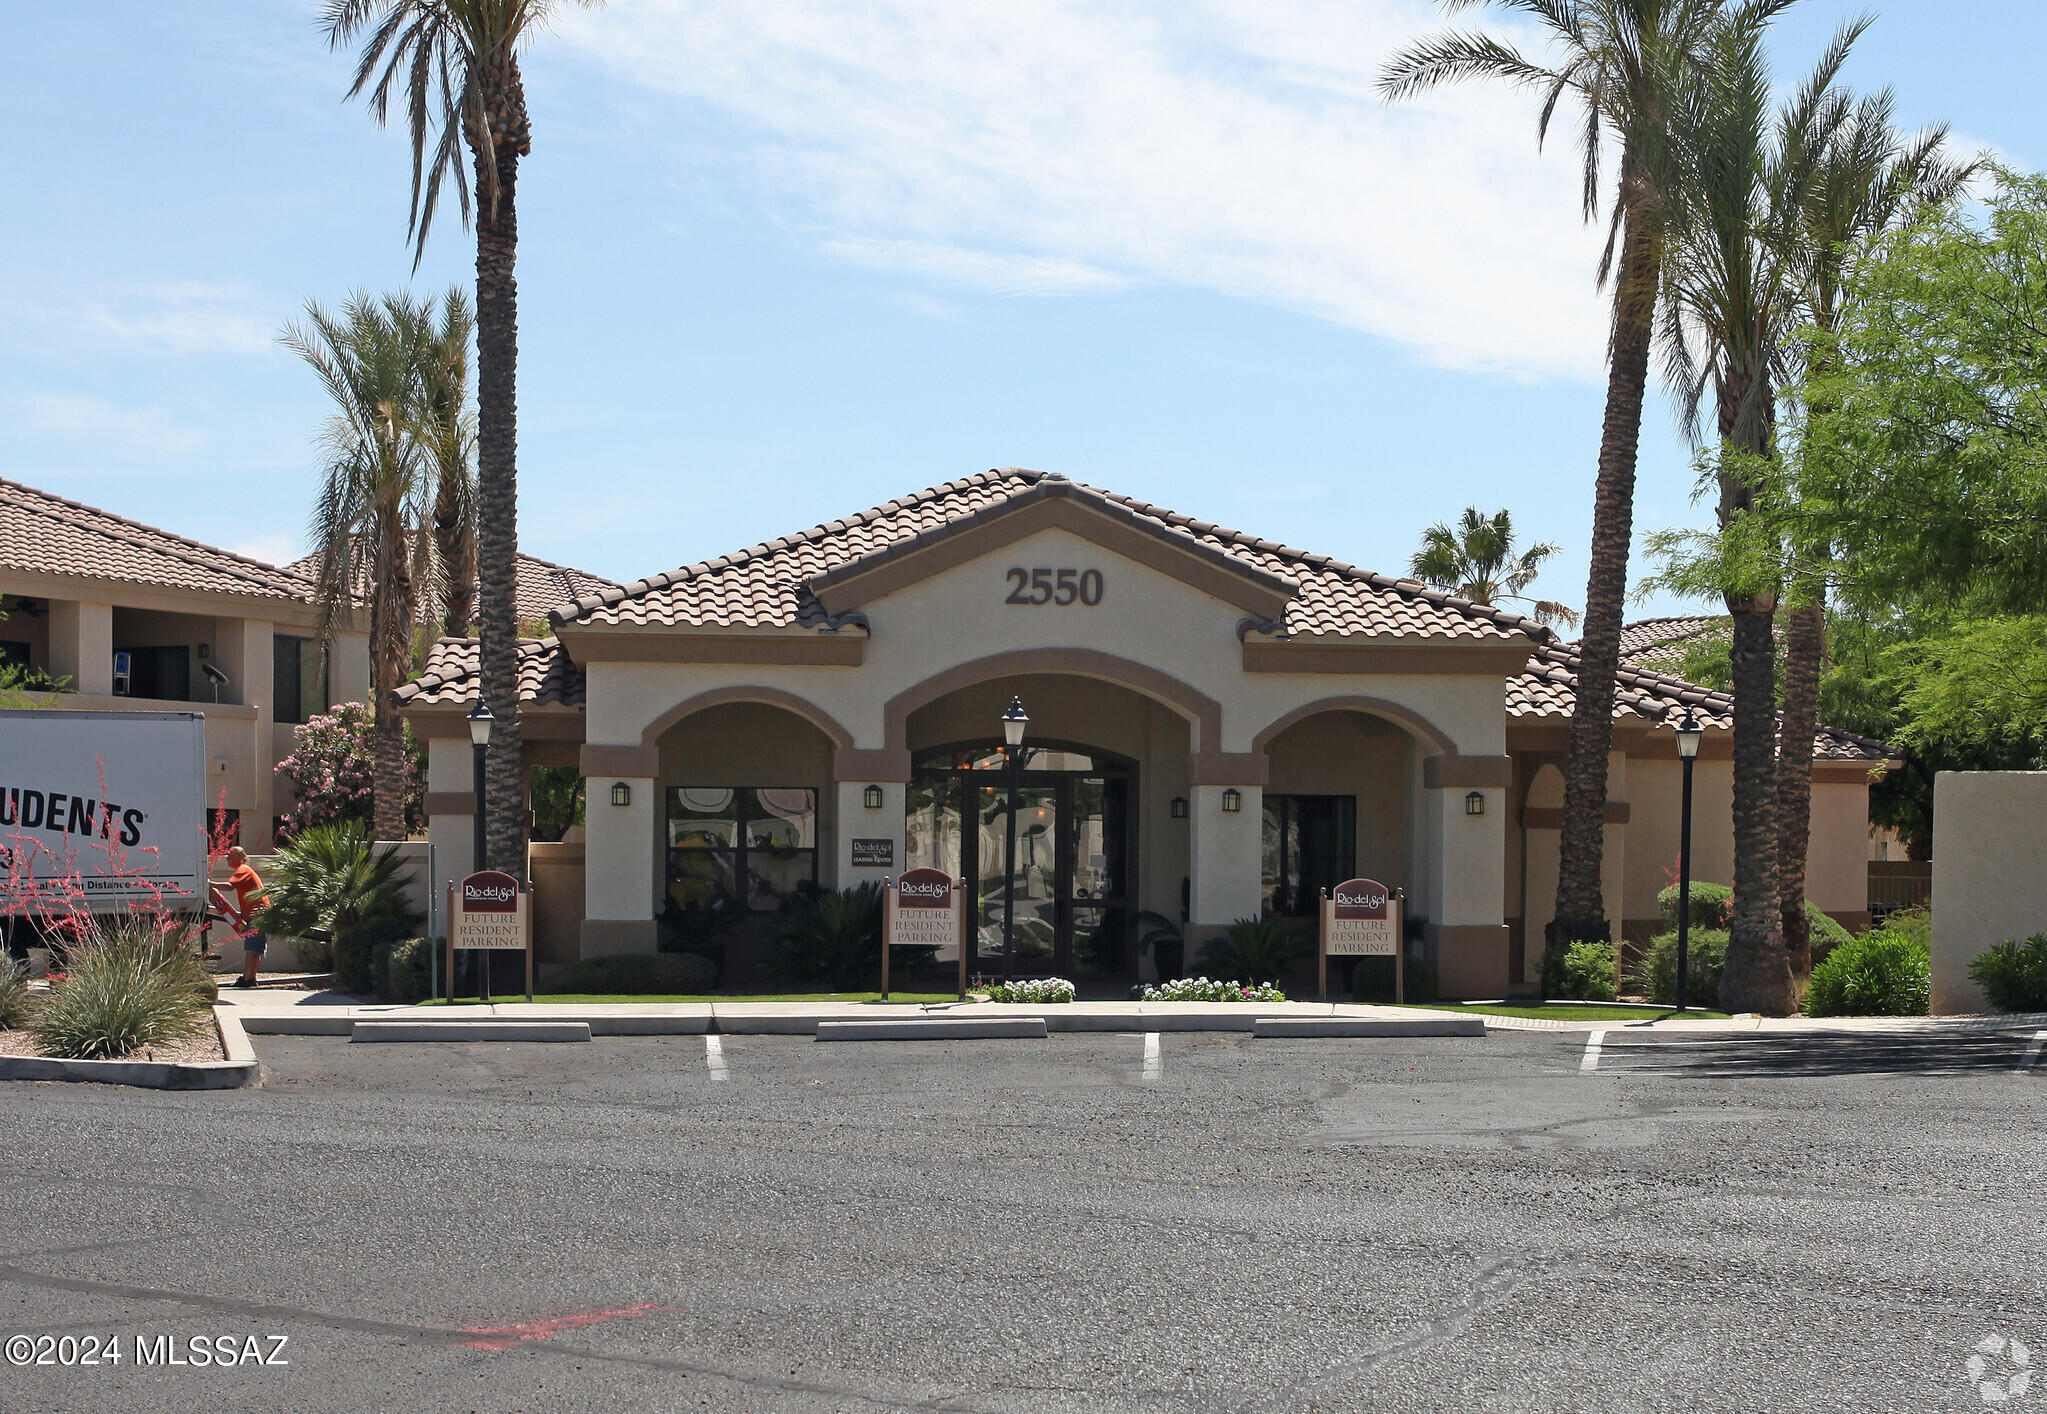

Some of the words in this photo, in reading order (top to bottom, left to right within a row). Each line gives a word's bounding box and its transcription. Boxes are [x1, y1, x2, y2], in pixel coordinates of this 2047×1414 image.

[1005, 567, 1104, 606] 2550
[464, 914, 517, 923] FUTURE
[900, 910, 951, 920] FUTURE
[460, 925, 520, 935] RESIDENT
[895, 920, 954, 931] RESIDENT
[1336, 921, 1387, 930] FUTURE
[898, 932, 952, 942] PARKING
[1332, 931, 1391, 941] RESIDENT
[463, 937, 519, 946] PARKING
[1335, 943, 1389, 953] PARKING
